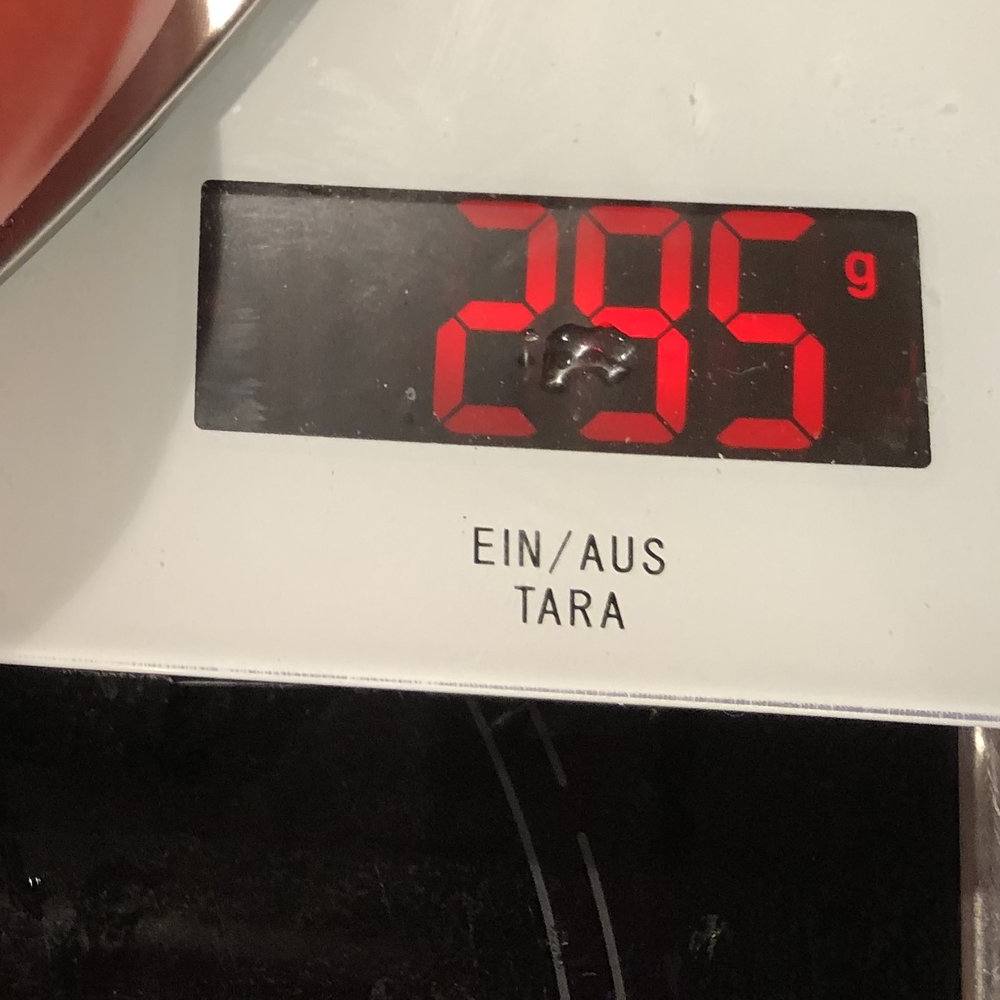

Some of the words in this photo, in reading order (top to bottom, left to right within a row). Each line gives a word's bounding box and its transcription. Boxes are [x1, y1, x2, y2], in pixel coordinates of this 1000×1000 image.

[433, 200, 827, 450] 295
[843, 250, 878, 300] g
[473, 526, 667, 576] EIN/AUS
[516, 586, 627, 631] TARA
